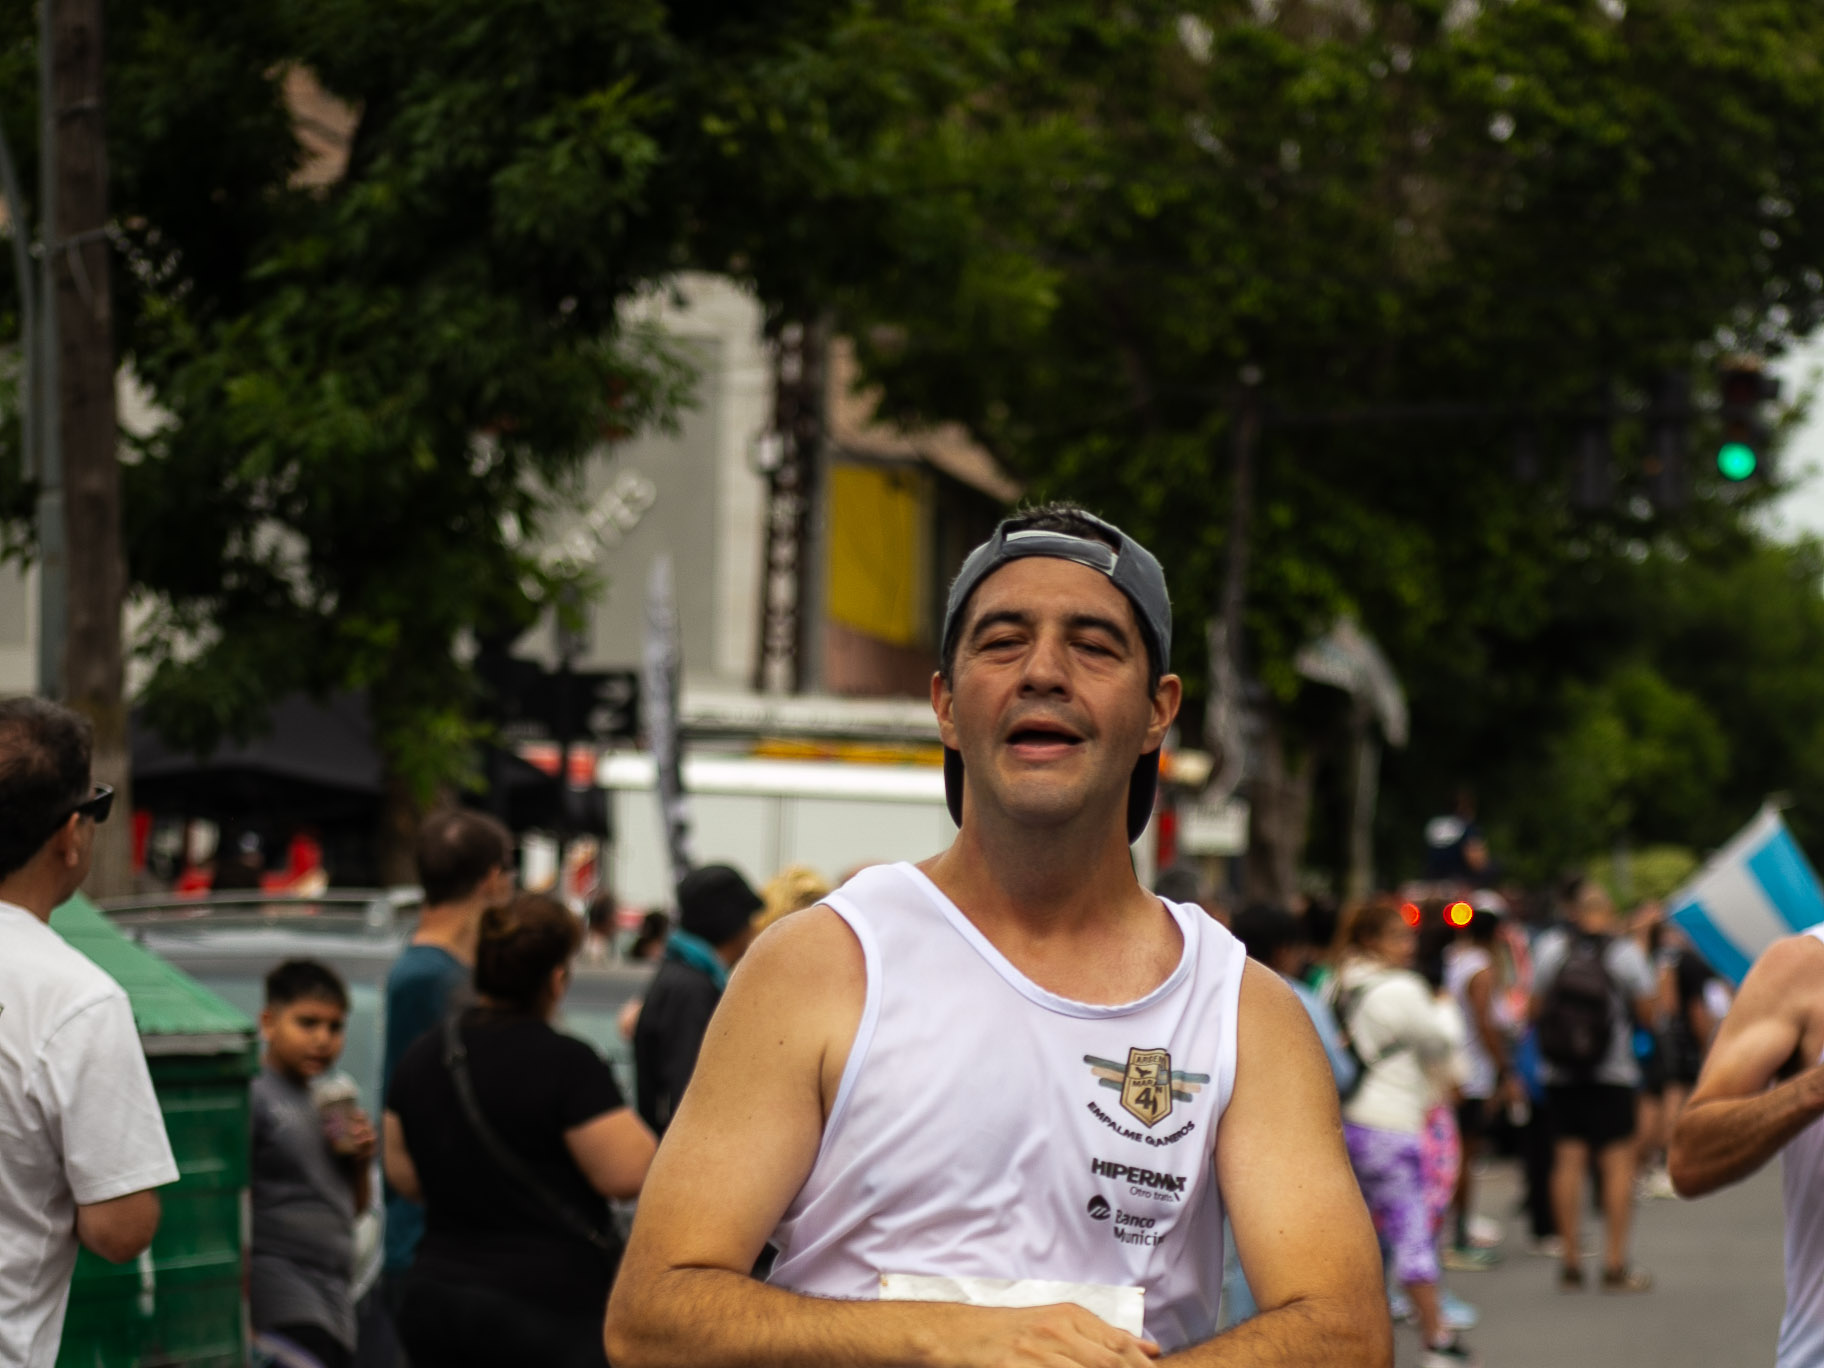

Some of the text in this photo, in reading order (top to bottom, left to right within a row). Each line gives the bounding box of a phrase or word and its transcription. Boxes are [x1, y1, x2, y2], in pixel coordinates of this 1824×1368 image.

[1087, 1101, 1143, 1142] EMPALME
[1129, 1186, 1152, 1198] Otro
[1115, 1209, 1156, 1228] Banco
